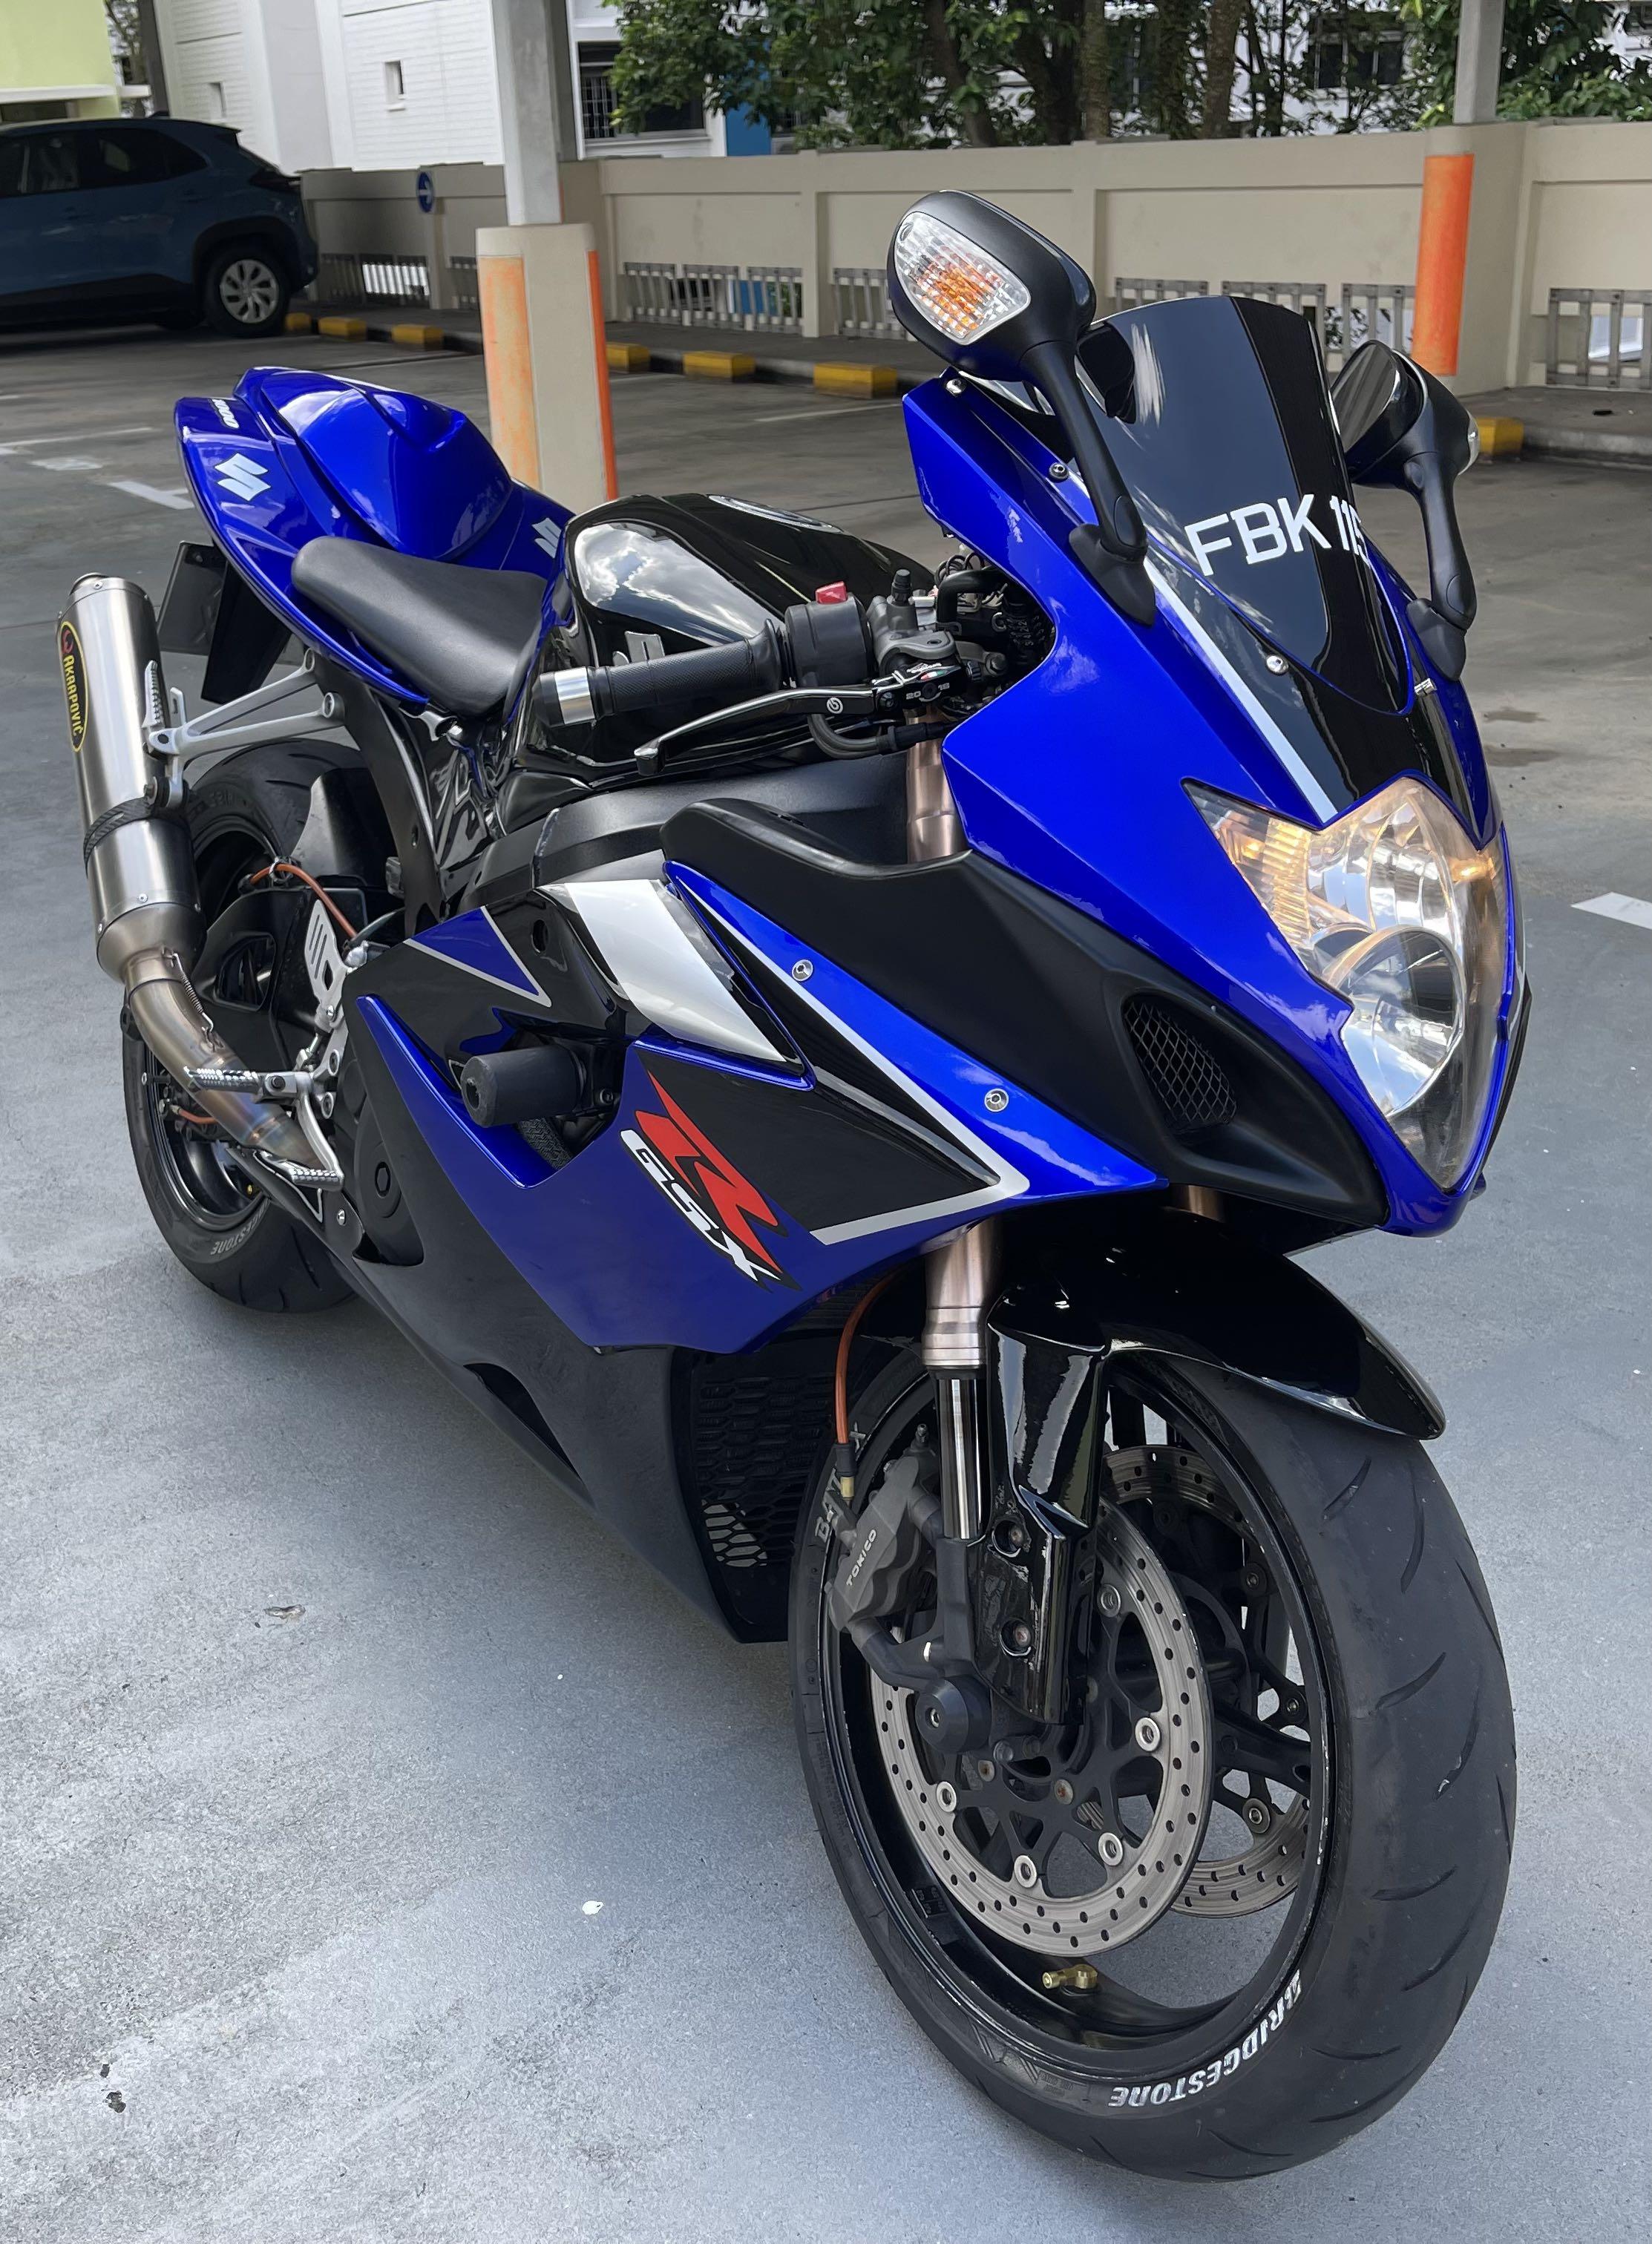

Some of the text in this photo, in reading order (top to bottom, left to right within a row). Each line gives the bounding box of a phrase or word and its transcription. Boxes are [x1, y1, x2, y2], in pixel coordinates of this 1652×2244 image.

[1184, 493, 1332, 577] FBK
[620, 1129, 781, 1282] GSX
[846, 1529, 877, 1587] TOKICO
[1107, 1968, 1302, 2108] BRIDGESTONE
